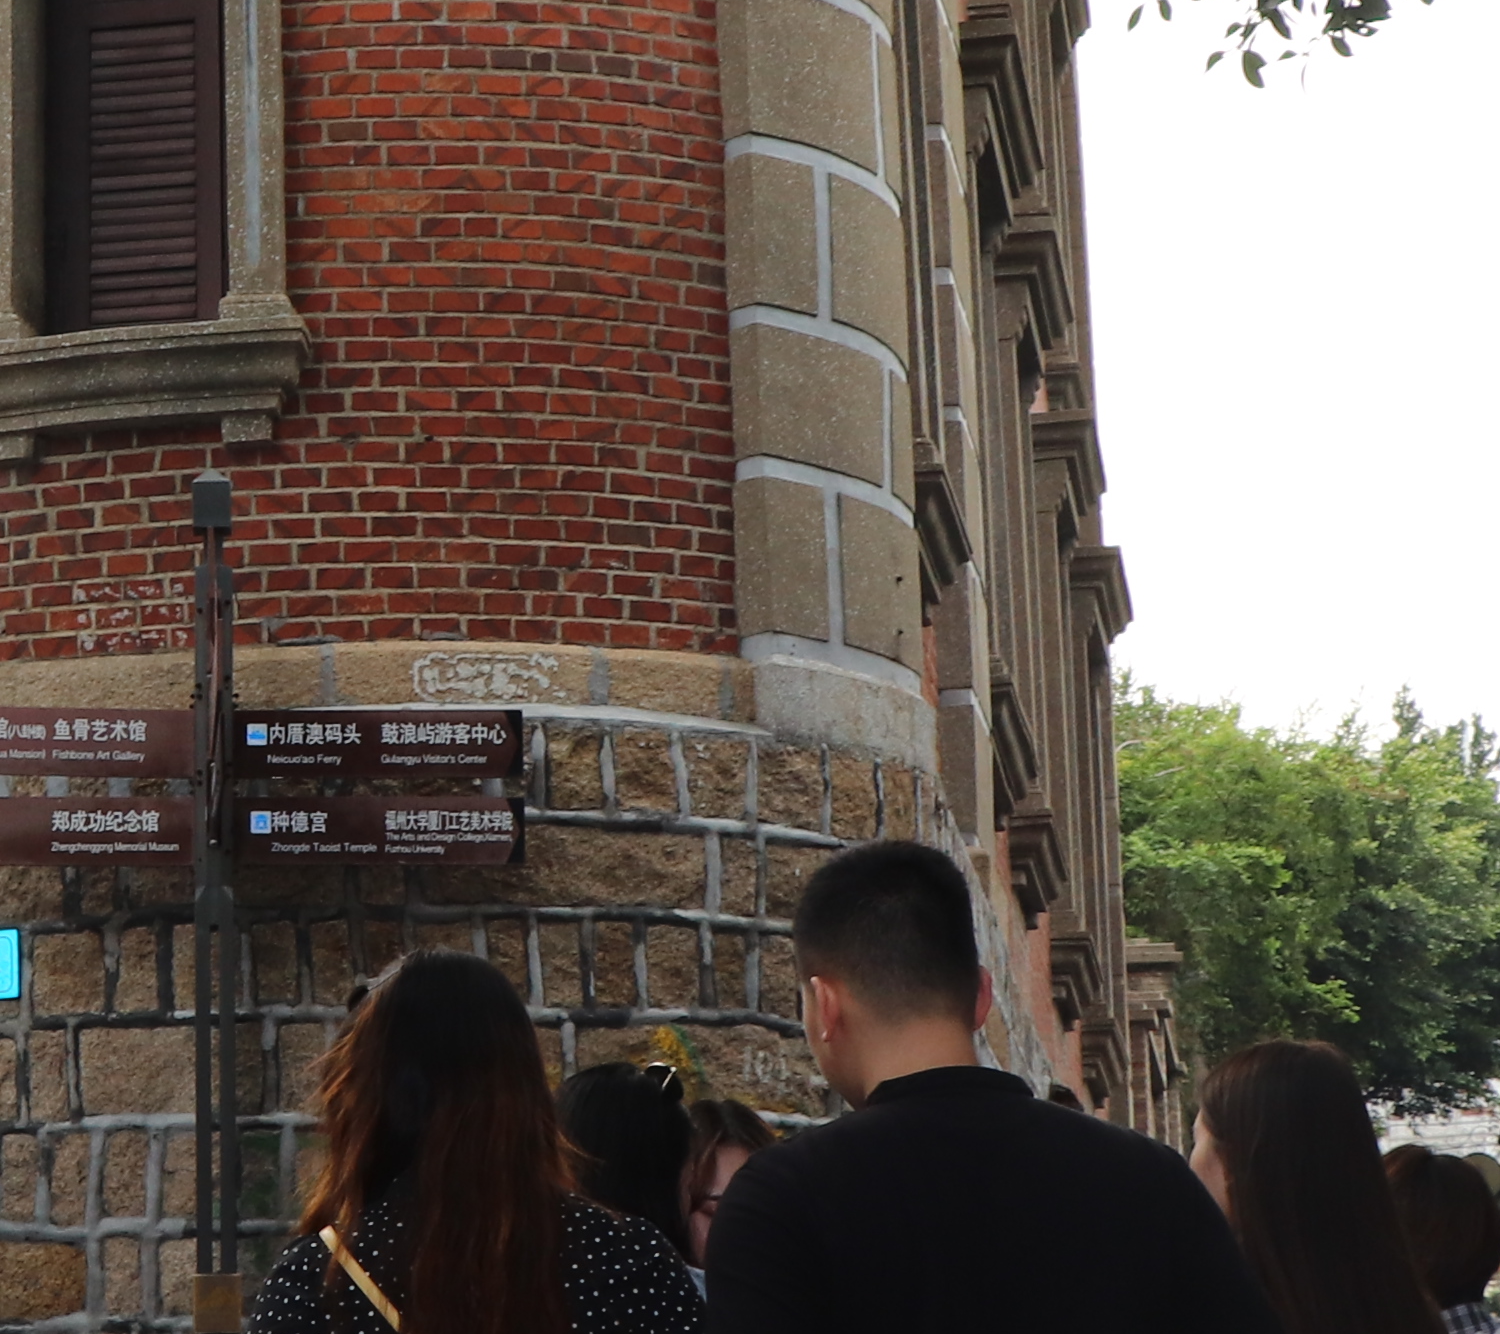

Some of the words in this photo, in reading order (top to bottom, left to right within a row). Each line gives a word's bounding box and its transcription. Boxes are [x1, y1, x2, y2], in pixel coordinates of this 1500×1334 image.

[53, 718, 148, 742] 鱼骨艺术馆
[268, 722, 362, 745] 内厝澳码头
[380, 722, 507, 745] 鼓浪屿游客中心
[52, 749, 94, 760] Fishbone
[96, 750, 110, 760] Art
[112, 750, 146, 762] Gallery
[316, 754, 342, 765] Ferry
[381, 754, 421, 766] Gulangyu
[422, 754, 456, 764] Visitor's
[457, 754, 488, 764] Center
[51, 810, 160, 833] 郑成功纪念馆
[272, 811, 328, 834] 种德宫
[385, 832, 399, 841] The
[400, 832, 416, 841] Arts
[114, 842, 148, 851] Memorial
[148, 842, 180, 852] Museum
[271, 842, 312, 854] Zhongde
[313, 842, 341, 852] Taoist
[343, 842, 378, 854] Temple
